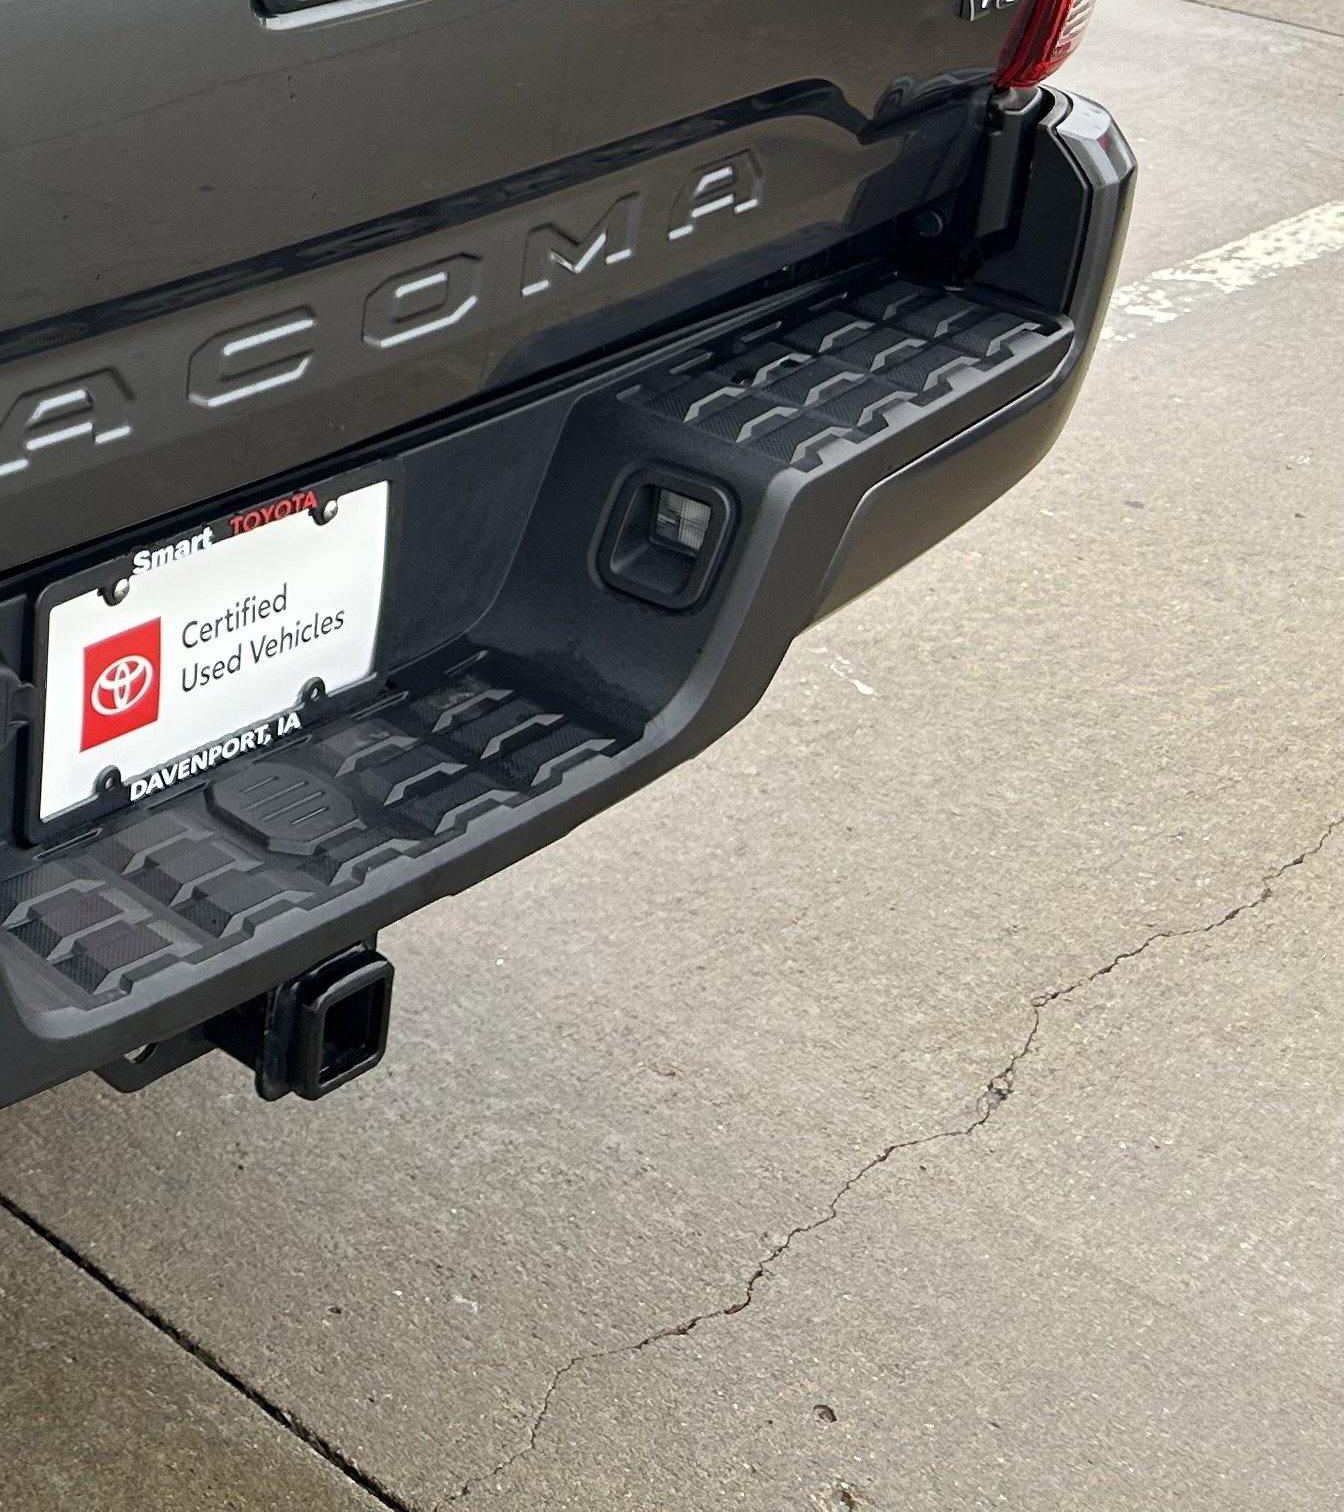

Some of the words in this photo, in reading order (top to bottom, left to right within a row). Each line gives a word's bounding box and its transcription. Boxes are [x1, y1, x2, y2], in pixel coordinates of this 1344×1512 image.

[132, 526, 213, 576] Smart
[229, 490, 317, 536] TOYOTA
[181, 583, 288, 649] Certified
[181, 644, 242, 693] Used
[249, 608, 346, 665] Vehicles
[129, 724, 271, 802] DAVENPORT,
[277, 711, 302, 736] IA
